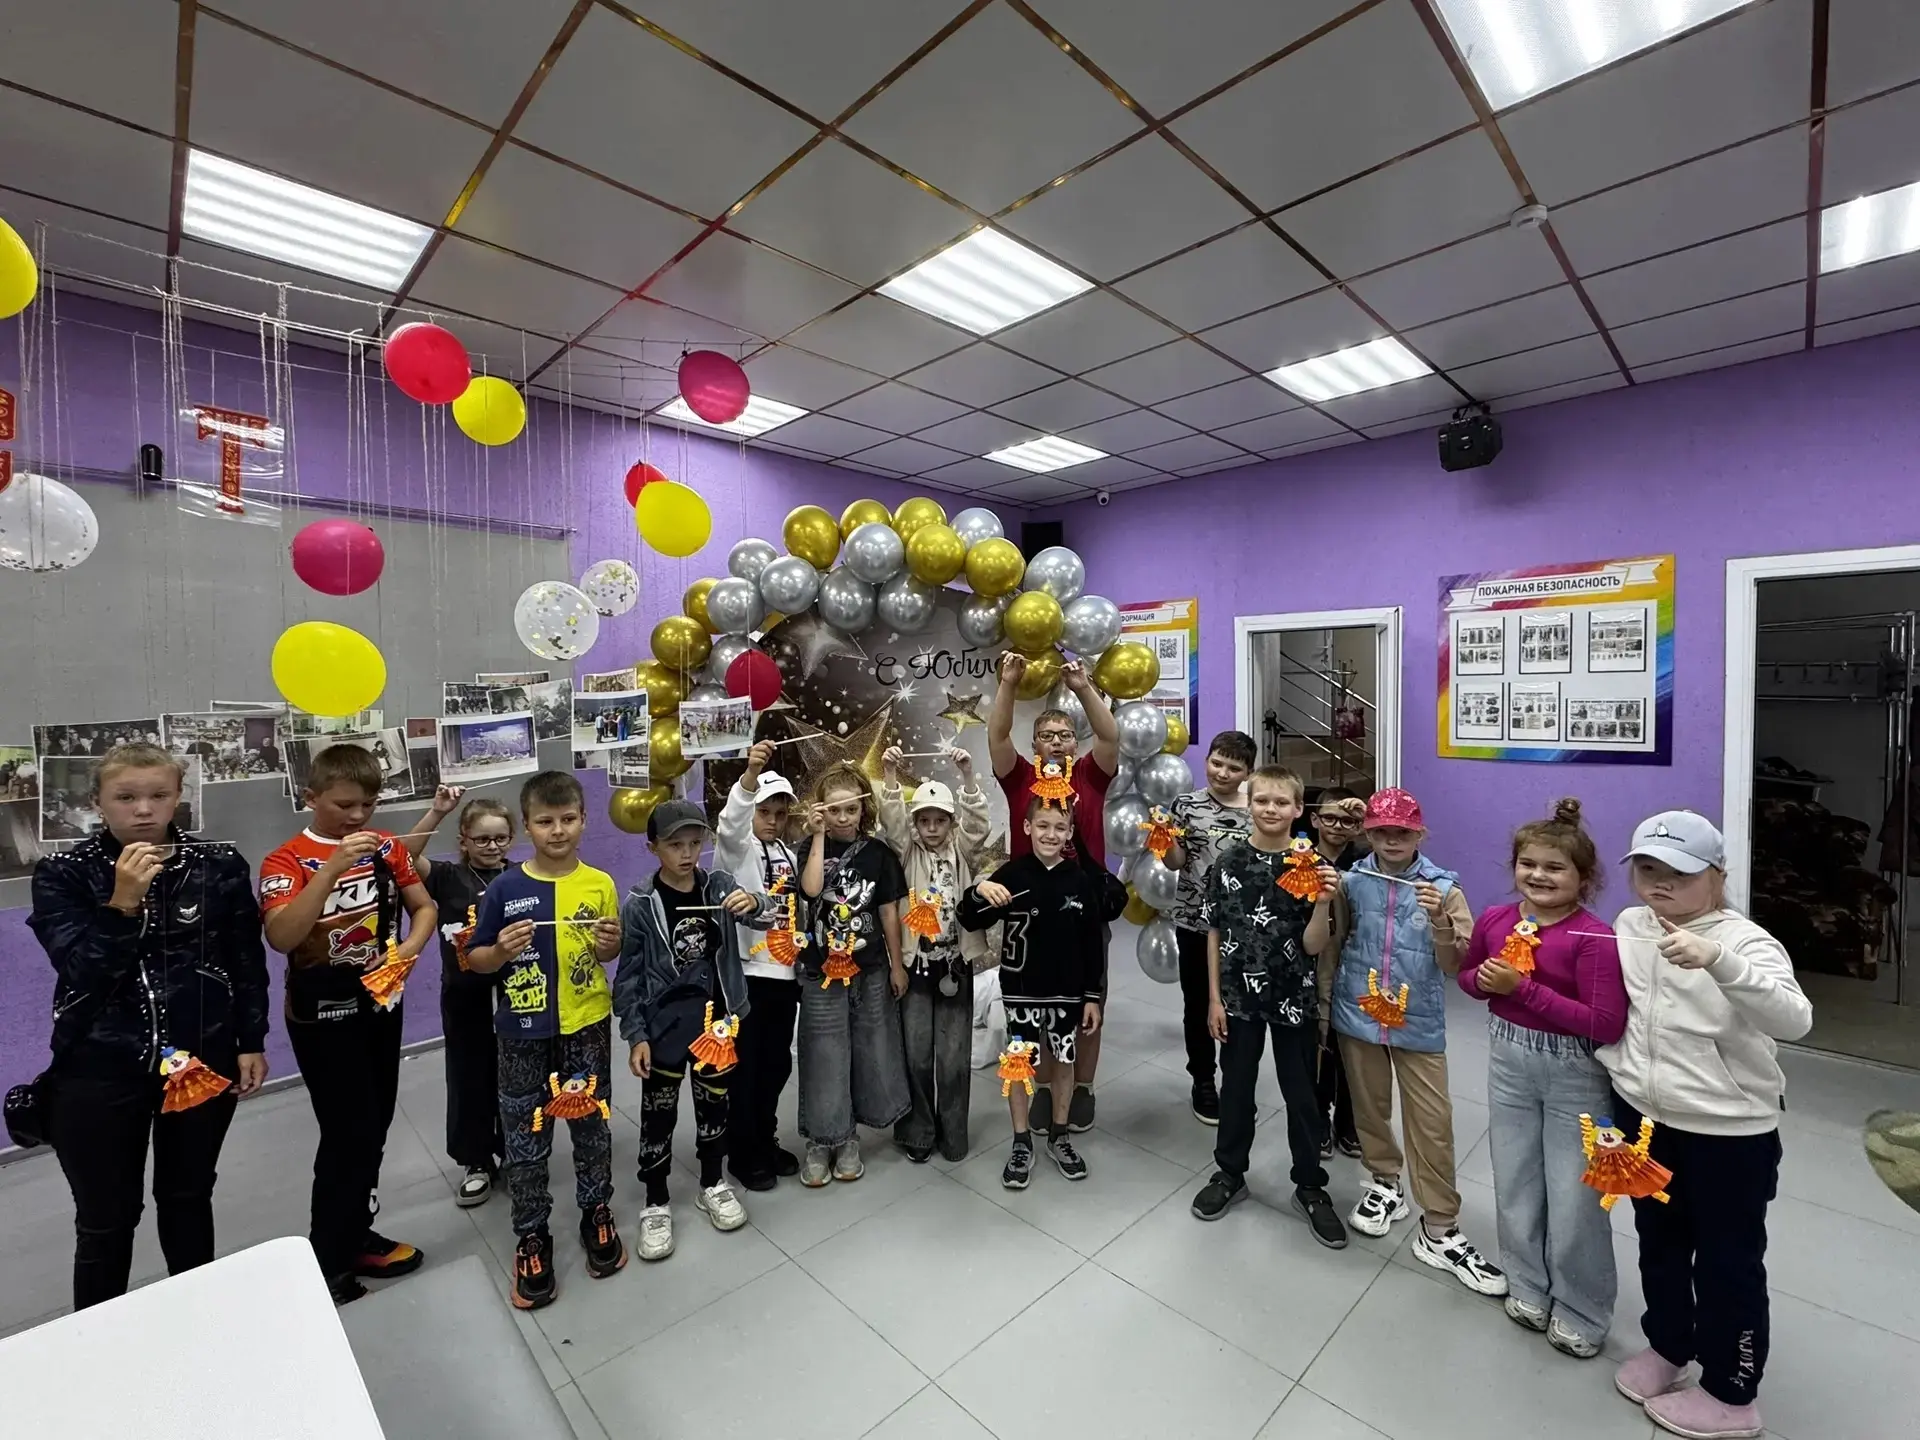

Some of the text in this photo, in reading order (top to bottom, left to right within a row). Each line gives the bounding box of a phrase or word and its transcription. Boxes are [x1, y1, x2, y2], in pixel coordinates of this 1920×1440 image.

[1478, 575, 1621, 597] ПОЖАРНАЯ БЕЗОПАСНОСТЬ
[1121, 612, 1155, 622] ФОРМАЦИЯ
[875, 646, 1000, 686] С Юбил
[1000, 911, 1030, 972] 3
[1738, 1329, 1755, 1374] ENJOY
